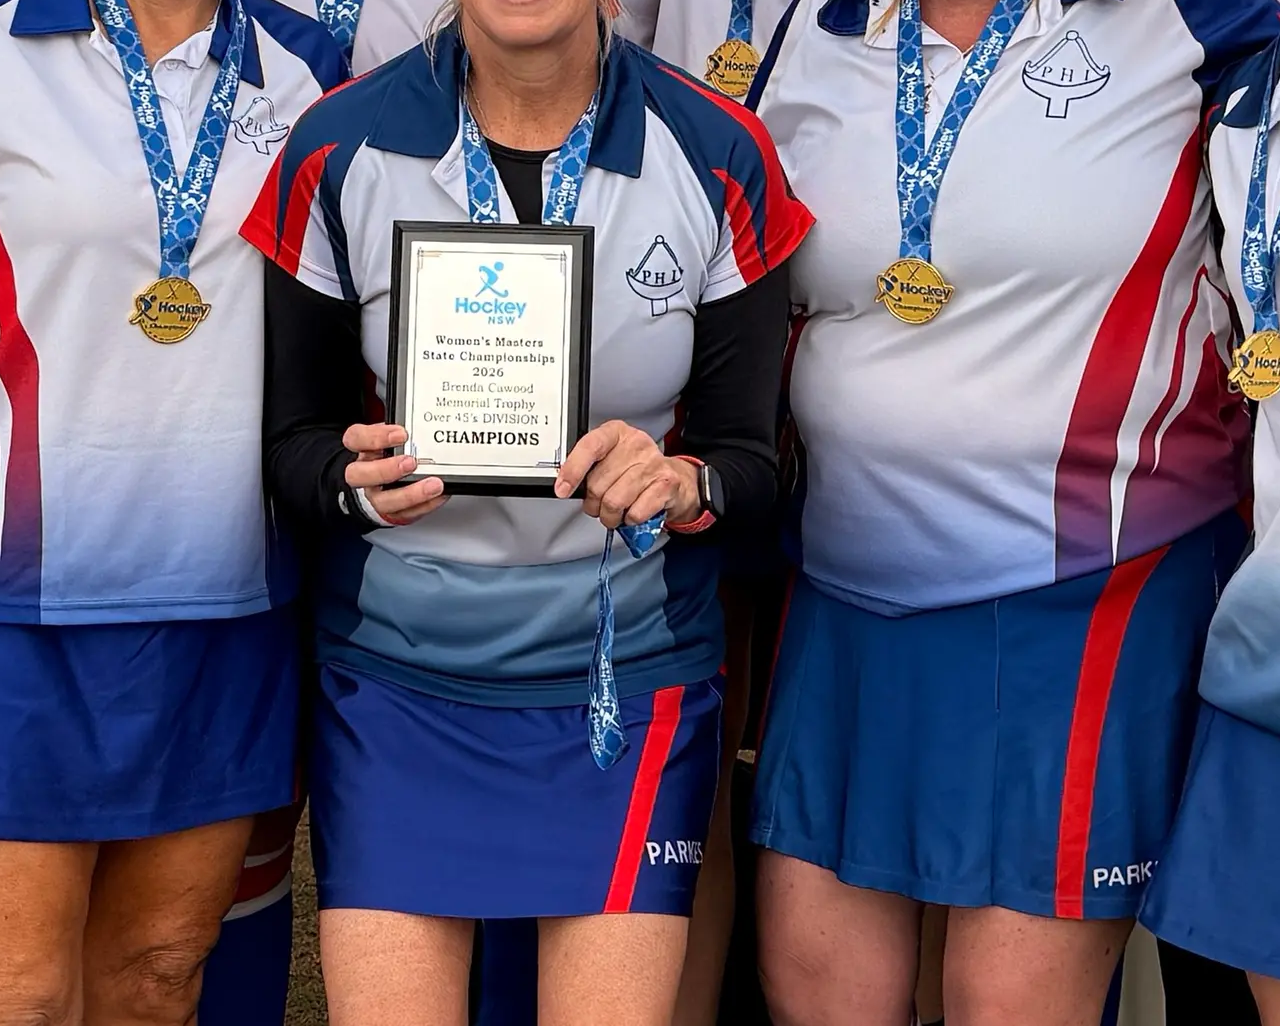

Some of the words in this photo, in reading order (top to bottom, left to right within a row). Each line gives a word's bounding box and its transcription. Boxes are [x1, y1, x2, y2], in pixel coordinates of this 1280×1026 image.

[975, 30, 1004, 71] Hockey
[218, 61, 238, 102] Hockey
[1040, 65, 1092, 83] PHI
[138, 84, 157, 130] Hockey
[927, 127, 954, 172] Hockey
[188, 153, 212, 195] Hockey
[551, 174, 575, 223] Hockey
[1248, 241, 1266, 291] Hockey
[641, 268, 682, 285] PHI
[900, 282, 952, 301] Hockey
[158, 301, 208, 316] Hockey
[455, 297, 528, 319] Hockey
[487, 315, 516, 326] NSW
[435, 334, 491, 347] Women's
[495, 337, 544, 349] Masters
[422, 350, 455, 362] State
[459, 351, 556, 366] Championships
[472, 366, 505, 378] 2026
[441, 381, 485, 394] Brenda
[487, 382, 535, 395] Cawood
[435, 396, 491, 410] Memorial
[493, 398, 536, 412] Trophy
[423, 412, 452, 424] Over
[454, 413, 479, 425] 45's
[482, 414, 540, 426] DIVISION
[543, 415, 550, 427] 1
[433, 429, 541, 447] CHAMPIONS
[646, 840, 704, 866] PARKES
[1093, 860, 1159, 889] PARK
